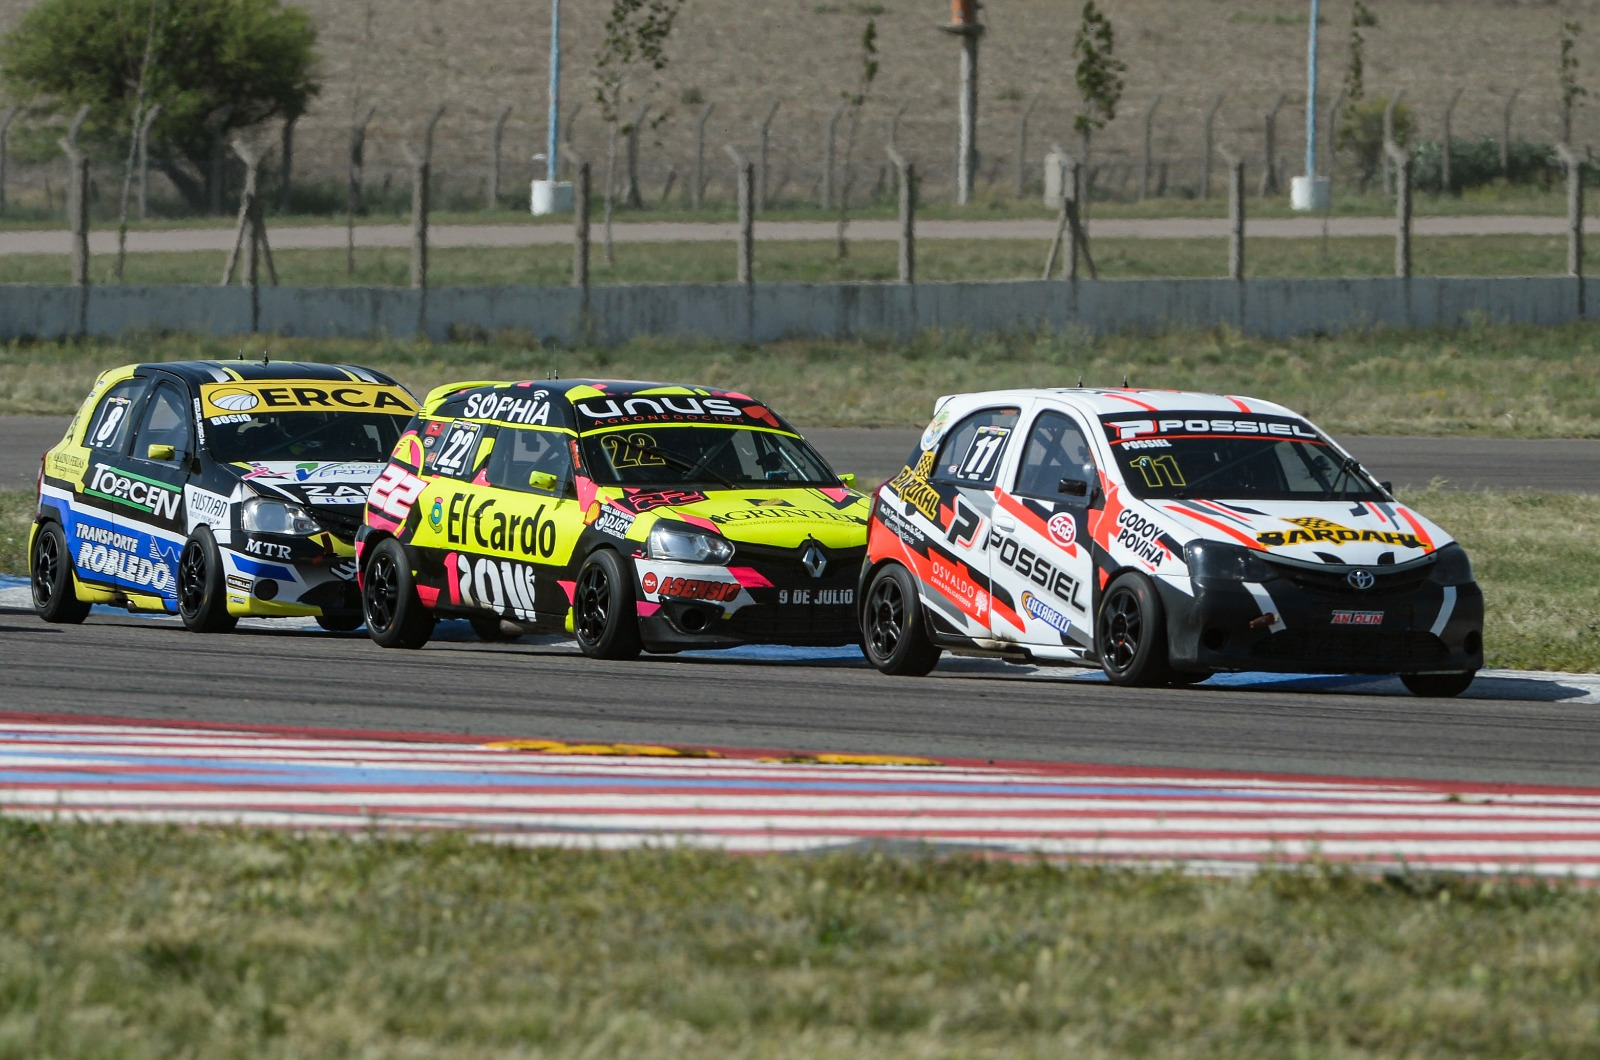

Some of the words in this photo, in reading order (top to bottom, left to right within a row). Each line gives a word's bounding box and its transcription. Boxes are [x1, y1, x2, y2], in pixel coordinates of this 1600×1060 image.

[258, 387, 415, 412] ERCA
[463, 392, 550, 425] SOPHIA
[97, 406, 123, 441] 8
[210, 415, 251, 426] BOSIO
[595, 415, 744, 425] AGRONEGOCIOS
[1159, 420, 1317, 438] POSSIEL
[437, 430, 474, 468] 22
[601, 433, 666, 468] 22
[965, 436, 1002, 473] 11
[1121, 439, 1172, 451] POSSIEL
[1129, 455, 1186, 487] 11
[190, 491, 228, 518] FUSTIAN
[300, 485, 370, 496] ZA
[367, 463, 429, 520] 22
[891, 468, 937, 518] BARDAHL
[76, 523, 138, 554] TRANSPORTE
[605, 514, 633, 534] DJGM
[1050, 516, 1075, 541] SGB
[1118, 508, 1165, 542] GODOY
[244, 539, 292, 560] MTR
[1117, 528, 1165, 567] POVIÑA
[77, 542, 170, 590] ROBLEDO
[932, 561, 974, 598] OSVALDO
[982, 530, 1086, 612] POSSIEL
[657, 576, 741, 602] ASENSIO
[779, 590, 788, 604] 9
[793, 590, 810, 604] DE
[814, 589, 854, 605] JULIO
